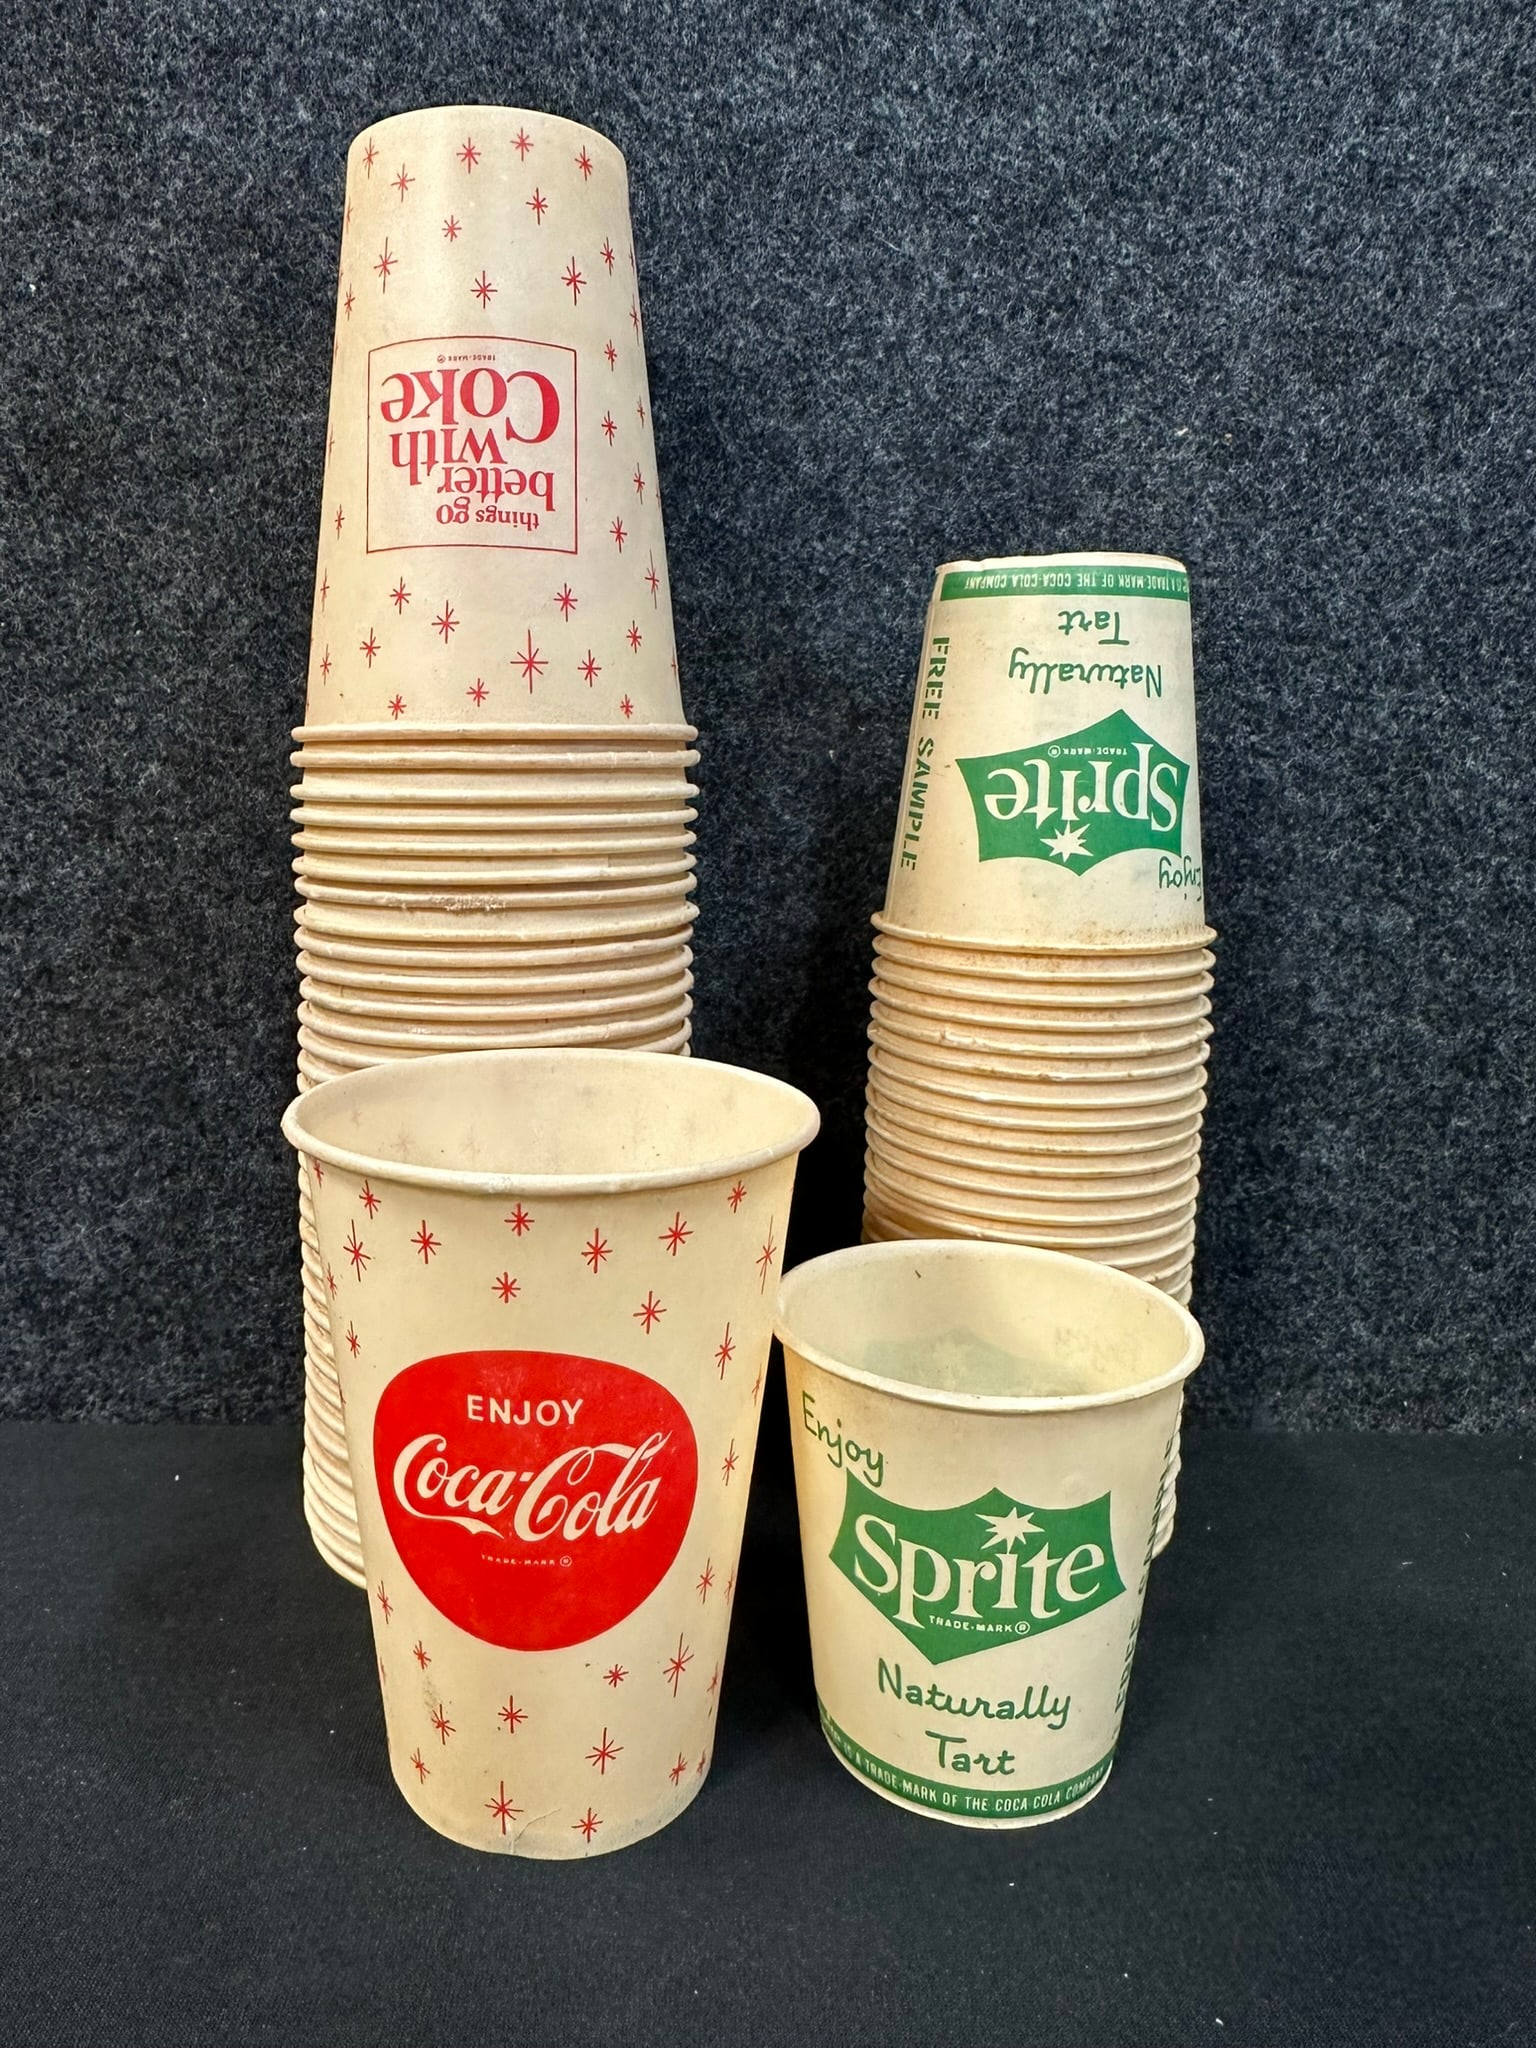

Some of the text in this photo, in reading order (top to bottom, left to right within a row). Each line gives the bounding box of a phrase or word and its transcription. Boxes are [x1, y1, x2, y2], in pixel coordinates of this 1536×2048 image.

[381, 368, 560, 444] Coke
[389, 428, 508, 486] with
[436, 496, 540, 531] things go
[437, 467, 556, 512] better
[964, 574, 1007, 590] COMPANY
[1077, 573, 1097, 588] THE
[1102, 573, 1115, 588] OF
[1059, 610, 1130, 646] Tart
[1008, 647, 1162, 698] Naturally
[900, 637, 950, 871] FREE SAMPLE
[984, 742, 1178, 862] Sprite
[467, 1394, 584, 1427] ENJOY
[802, 1390, 885, 1488] Enjoy
[393, 1430, 673, 1542] Coca-Cola
[854, 1507, 1105, 1629] Sprite
[877, 1657, 1071, 1730] Naturally
[925, 1730, 1016, 1776] Tart
[942, 1792, 958, 1807] OF
[965, 1796, 989, 1811] THE
